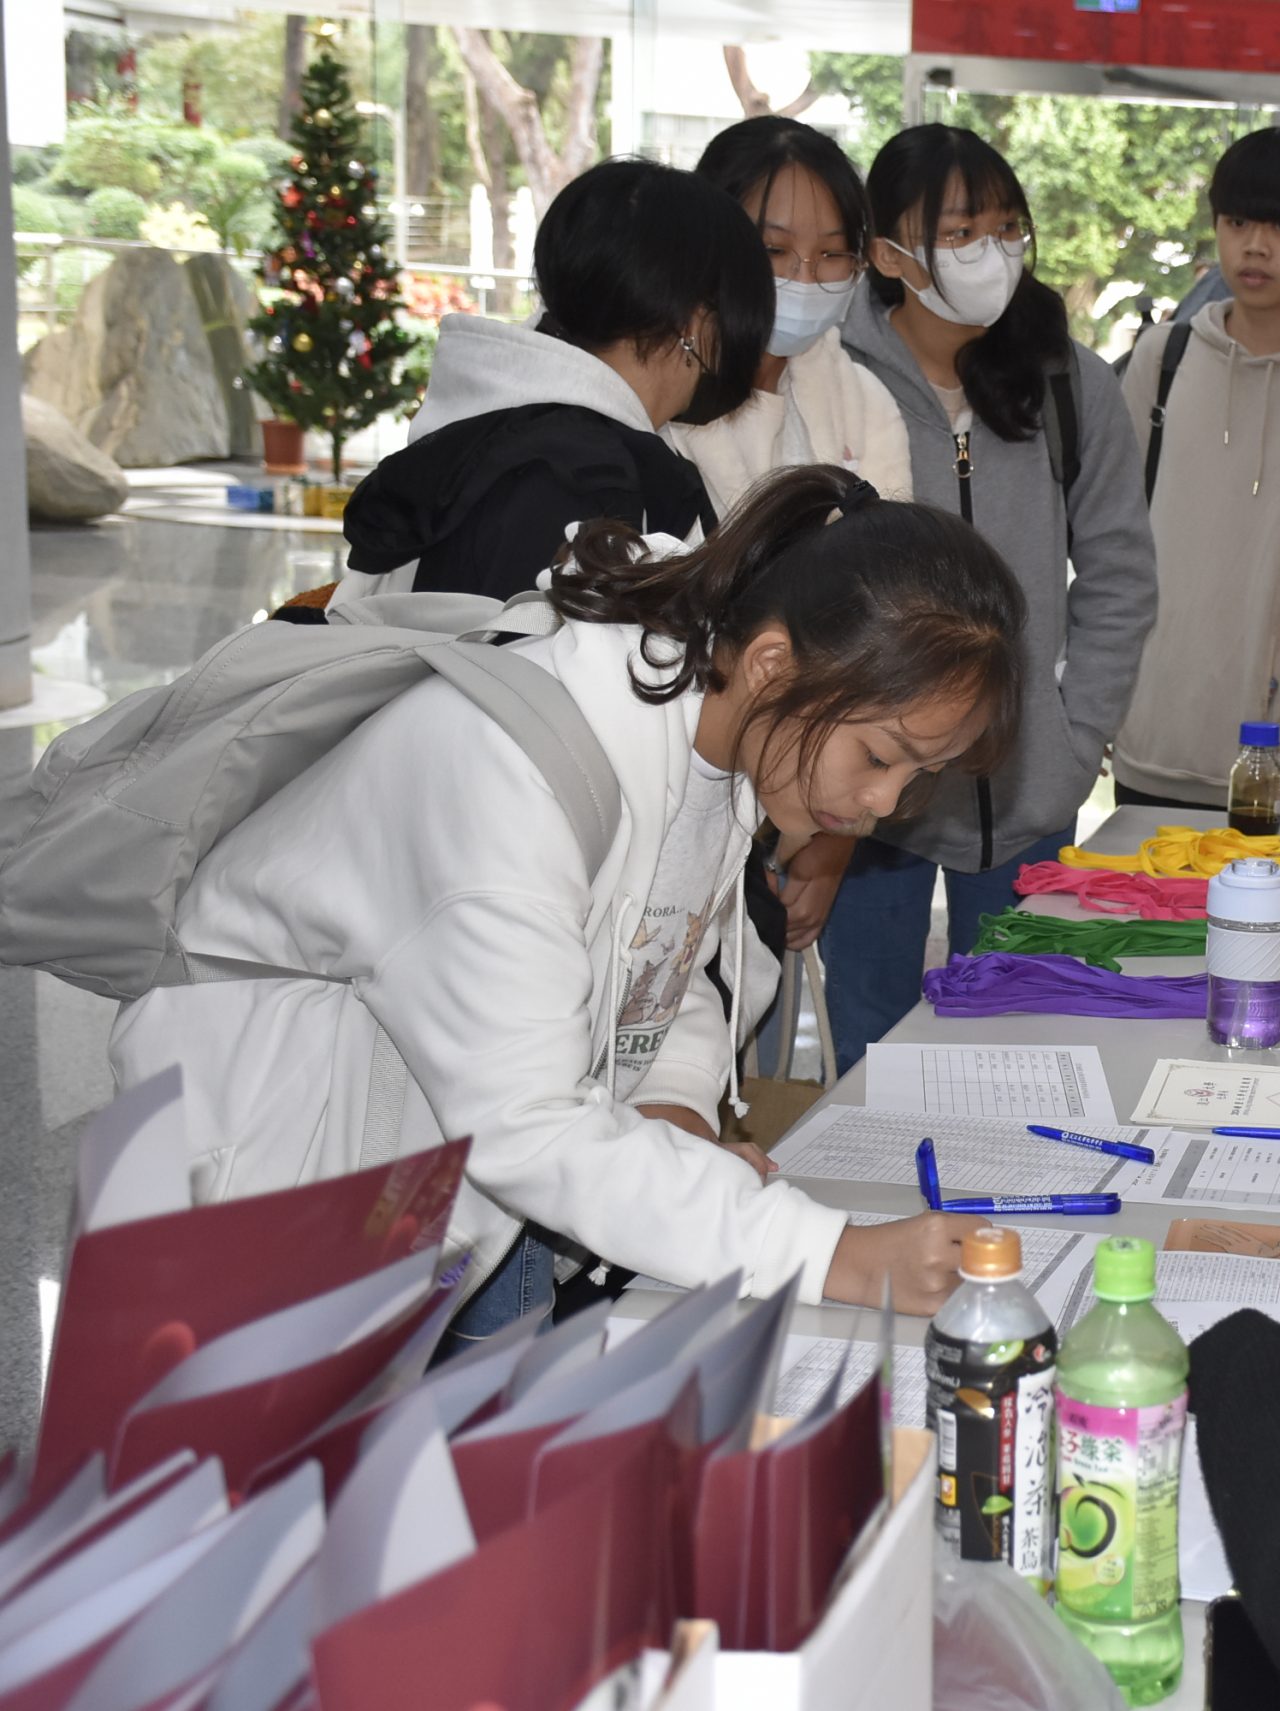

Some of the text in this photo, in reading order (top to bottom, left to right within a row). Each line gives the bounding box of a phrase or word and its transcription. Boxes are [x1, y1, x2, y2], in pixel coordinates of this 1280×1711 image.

[616, 1026, 670, 1055] ERE
[1024, 1385, 1050, 1517] 冷泡茶
[1060, 1430, 1123, 1463] 子綠茶
